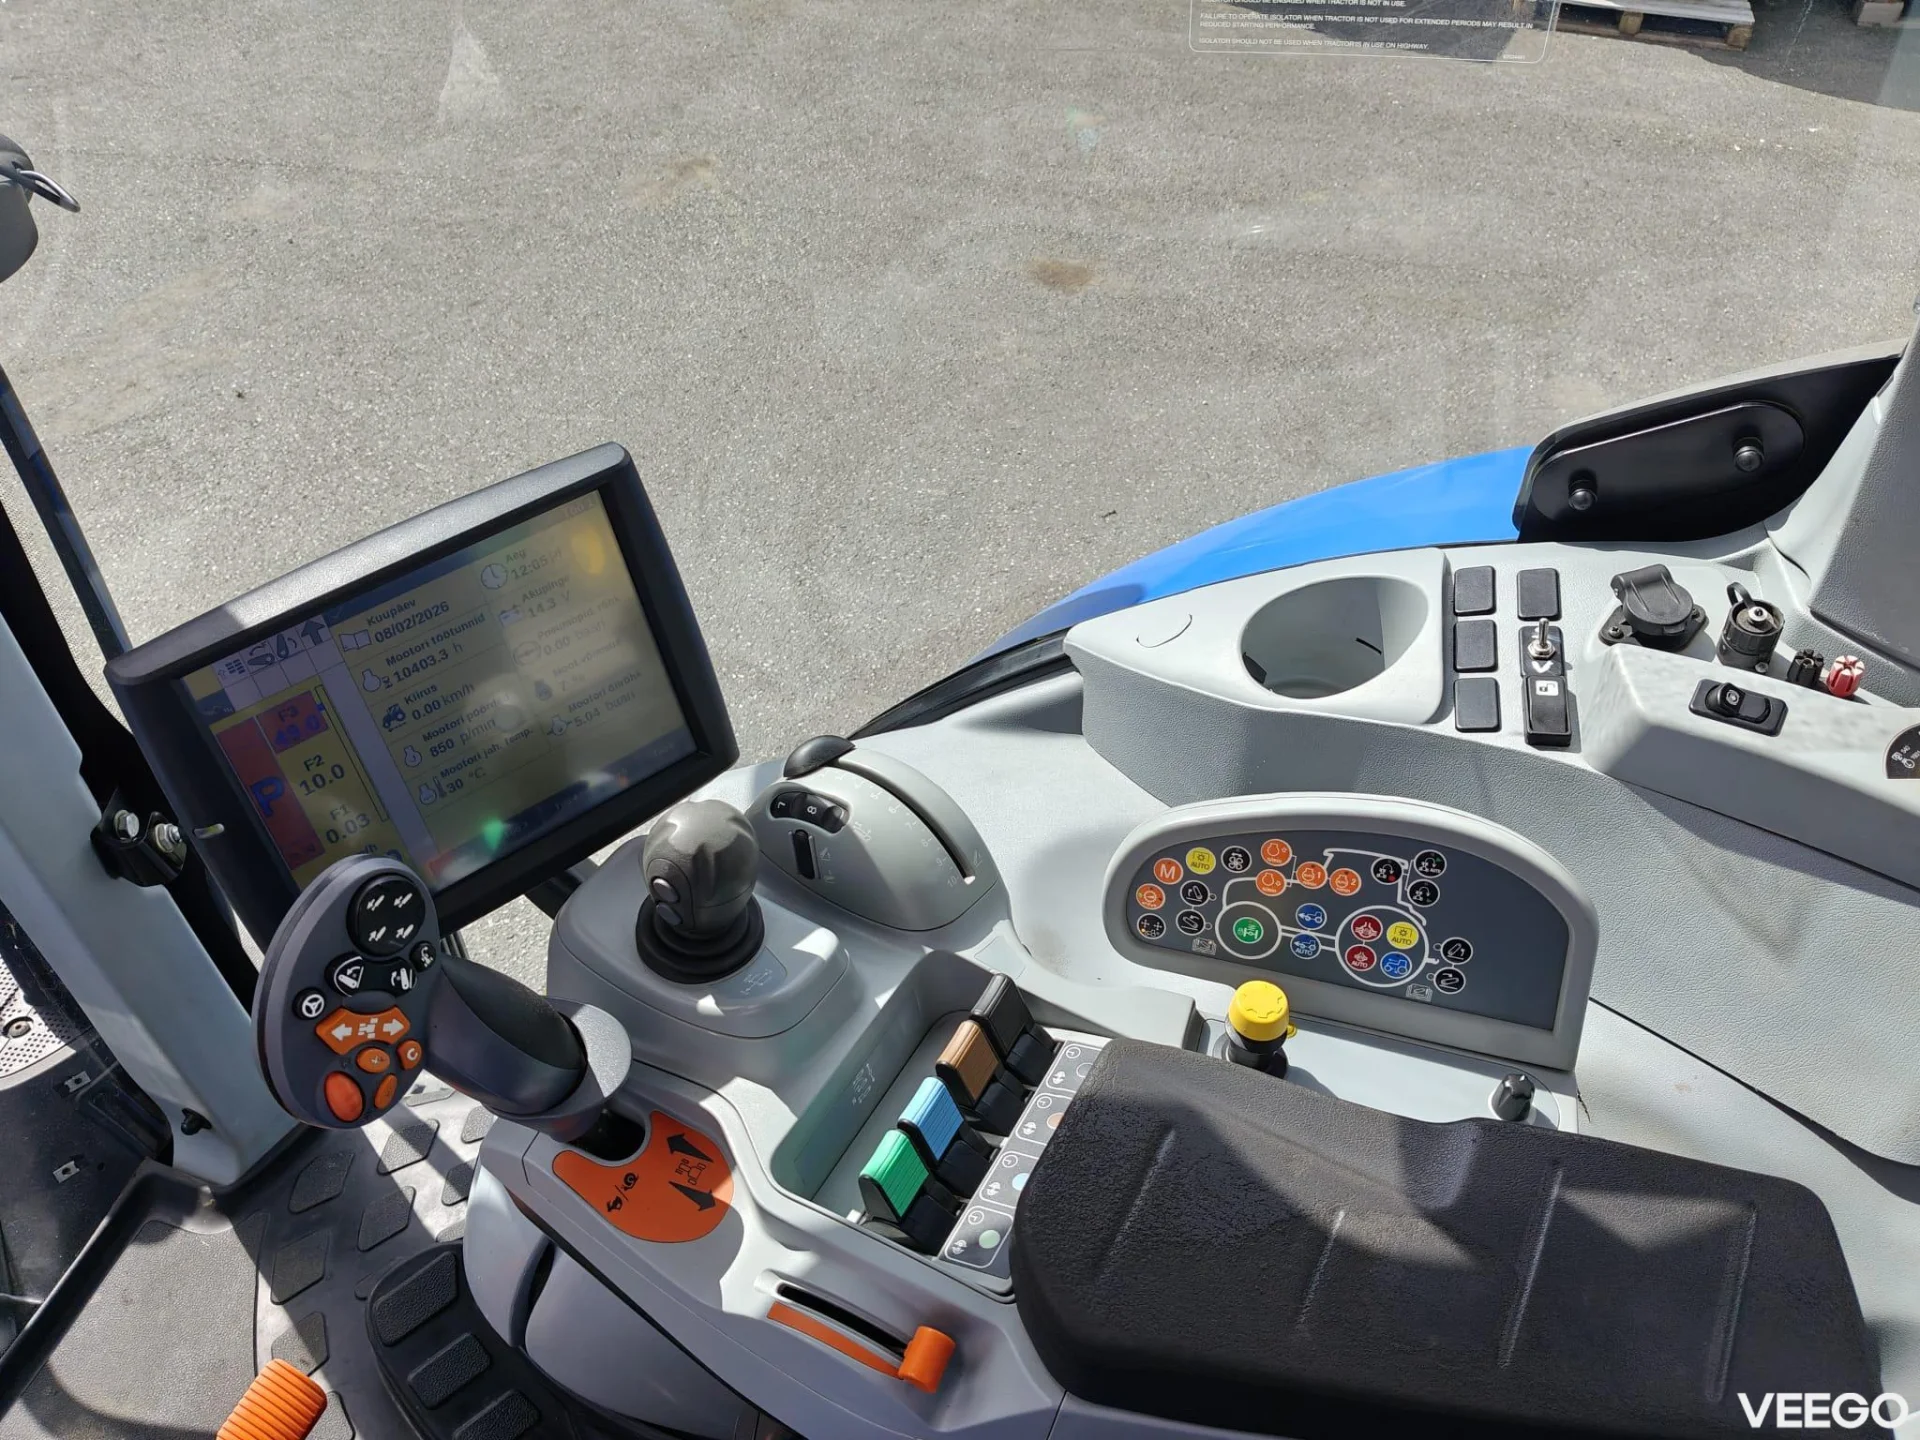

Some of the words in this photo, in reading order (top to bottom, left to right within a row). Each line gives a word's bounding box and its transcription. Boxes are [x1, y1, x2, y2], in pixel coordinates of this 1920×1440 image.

[1451, 19, 1481, 27] PERIODS
[366, 599, 416, 627] Kuupäev
[374, 601, 450, 643] 08/02/2026
[385, 641, 429, 667] Mootori
[393, 648, 449, 683] 10403.3
[452, 642, 464, 655] h
[404, 683, 439, 706] Kiirus
[411, 700, 441, 721] 0.00
[441, 683, 475, 707] km/h
[277, 704, 299, 722] F3
[422, 716, 465, 743] Mootori
[429, 738, 455, 758] 850
[303, 754, 325, 772] F2
[440, 752, 482, 780] Mootori
[300, 763, 345, 796] 10.0
[446, 778, 464, 794] 30
[251, 776, 285, 818] P
[329, 803, 349, 820] F1
[806, 805, 817, 815] 8
[325, 812, 371, 844] 0.03
[1160, 863, 1175, 880] M
[1190, 861, 1210, 870] AUTO
[1350, 878, 1357, 886] 2
[1392, 937, 1412, 945] AUTO
[1295, 948, 1313, 956] AUTO
[1351, 960, 1368, 968] AUTO
